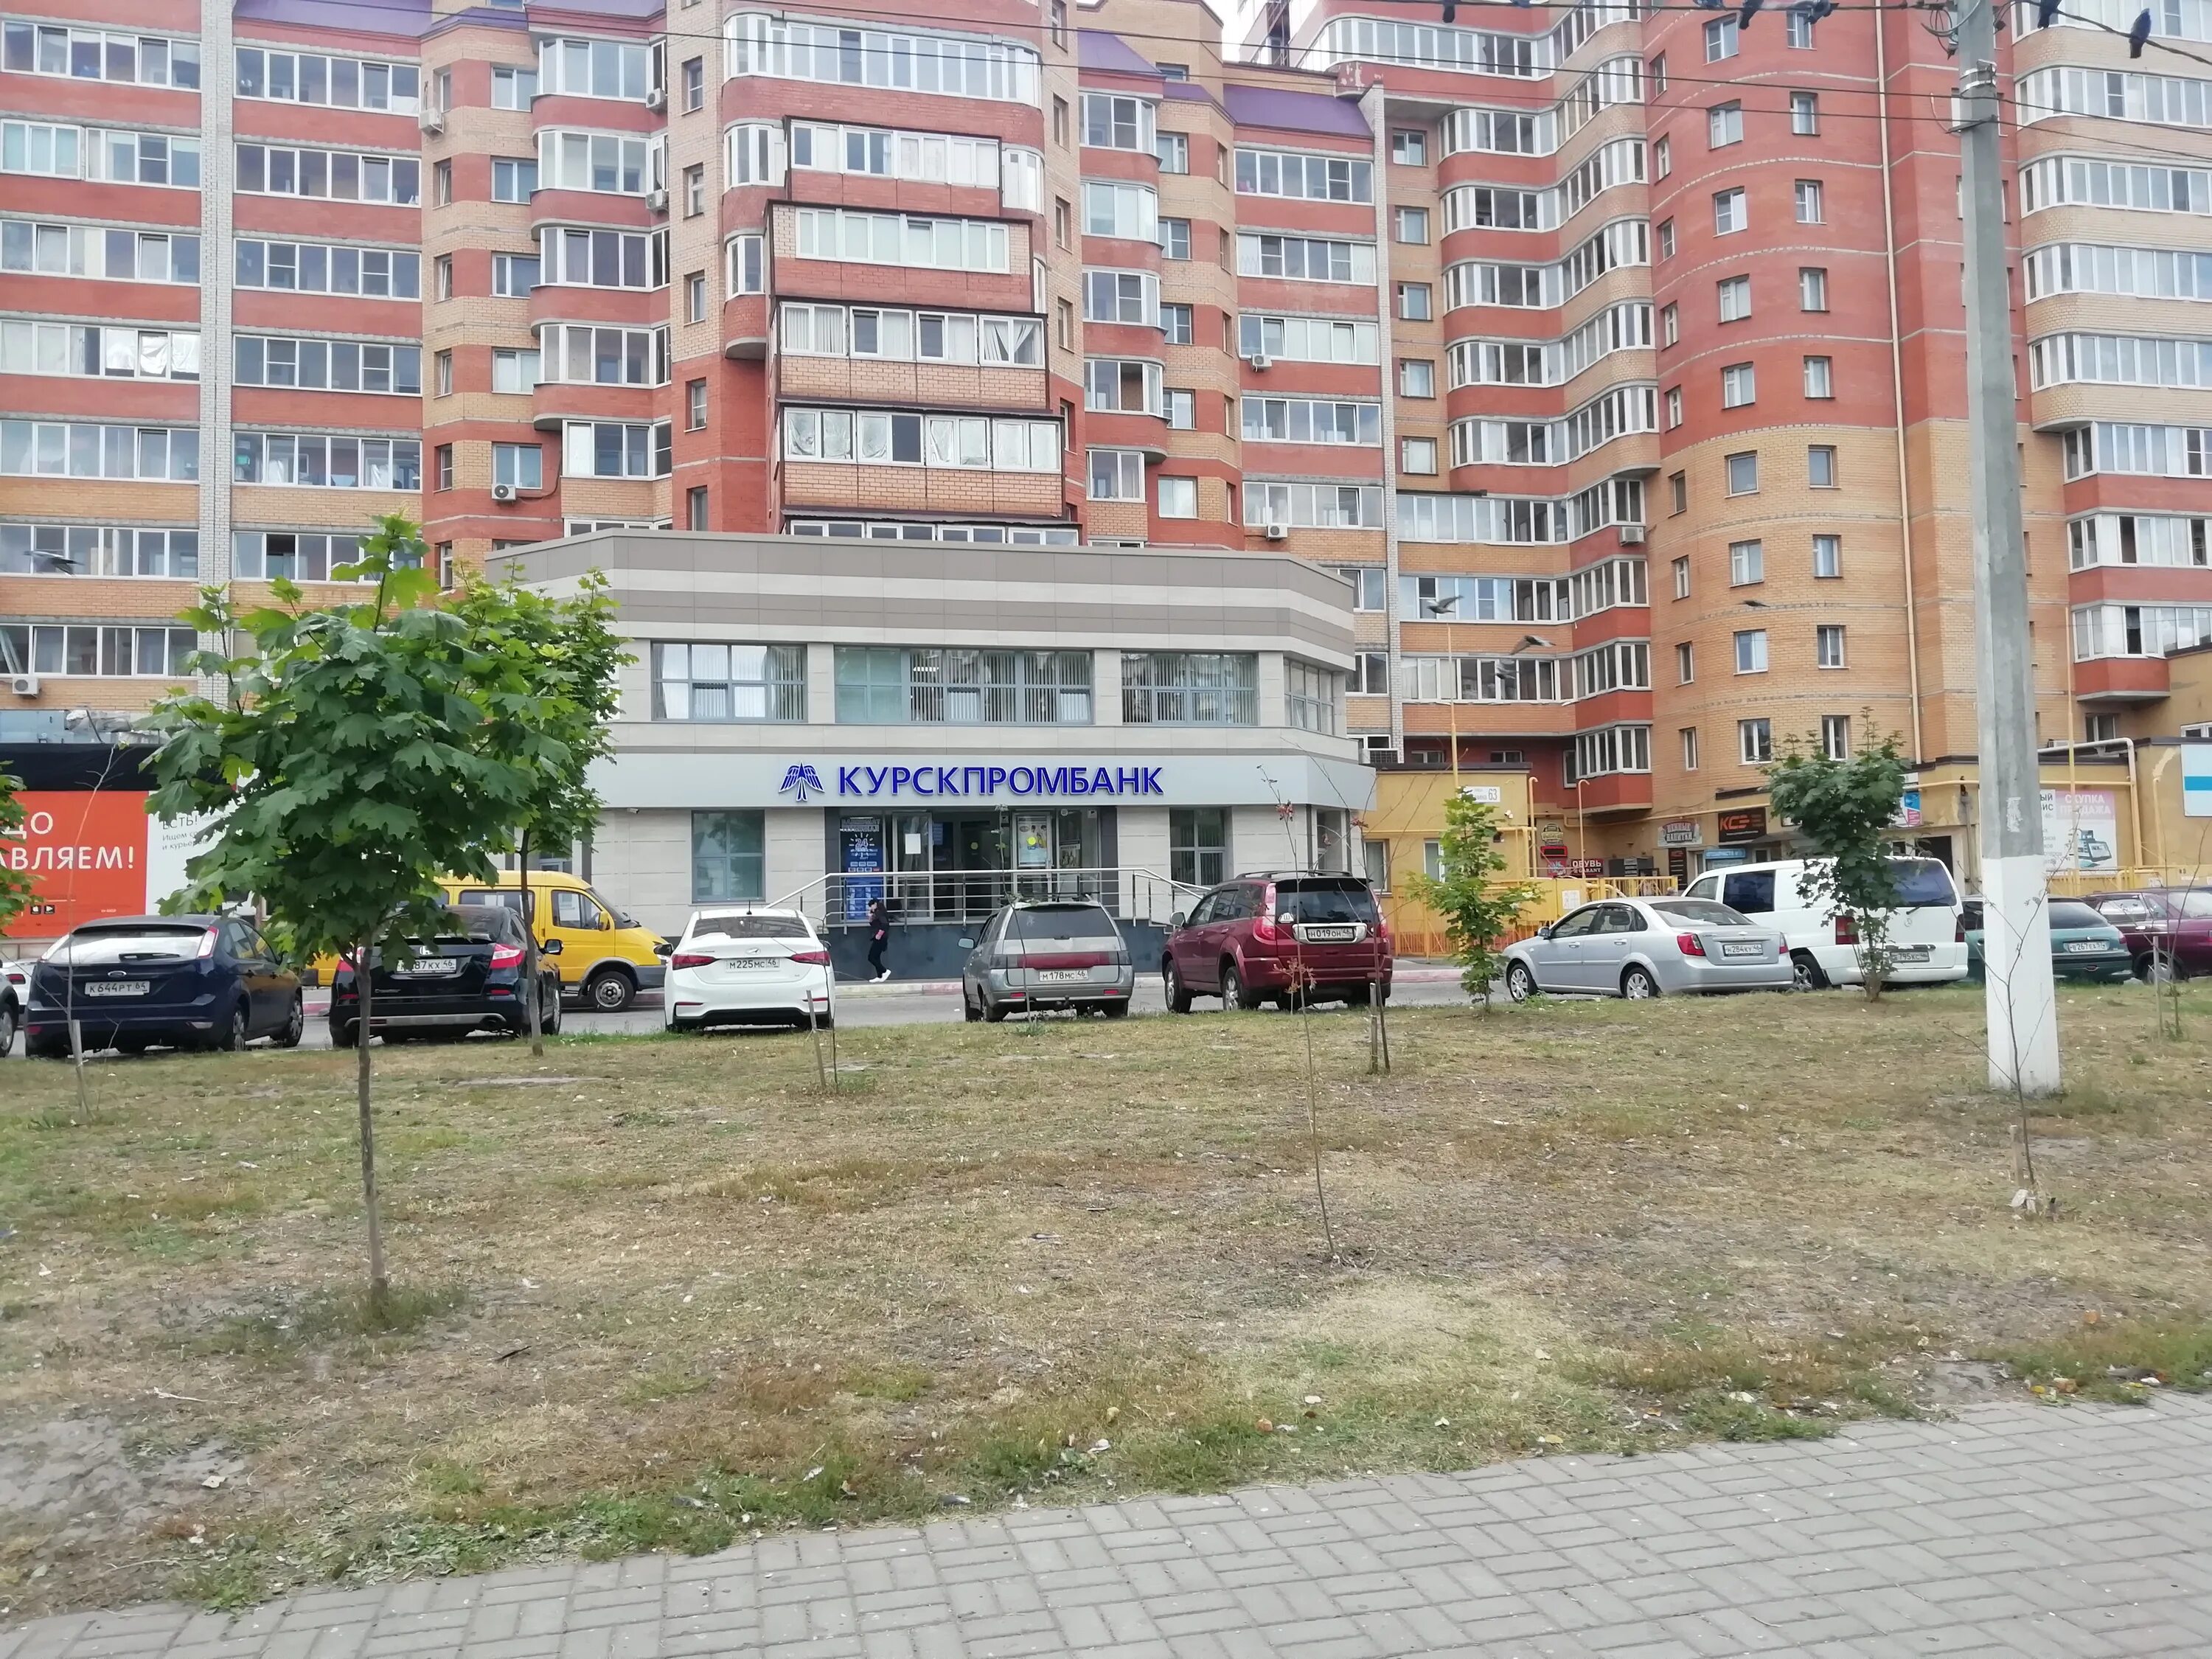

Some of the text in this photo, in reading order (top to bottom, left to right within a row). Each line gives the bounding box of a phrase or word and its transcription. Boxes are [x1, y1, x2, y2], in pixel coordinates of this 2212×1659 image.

[838, 766, 1164, 796] КУРСКПРОМБАНК
[1488, 788, 1498, 801] 63
[2065, 795, 2105, 804] СУПКА
[1572, 860, 1601, 868] ОБУВЬ
